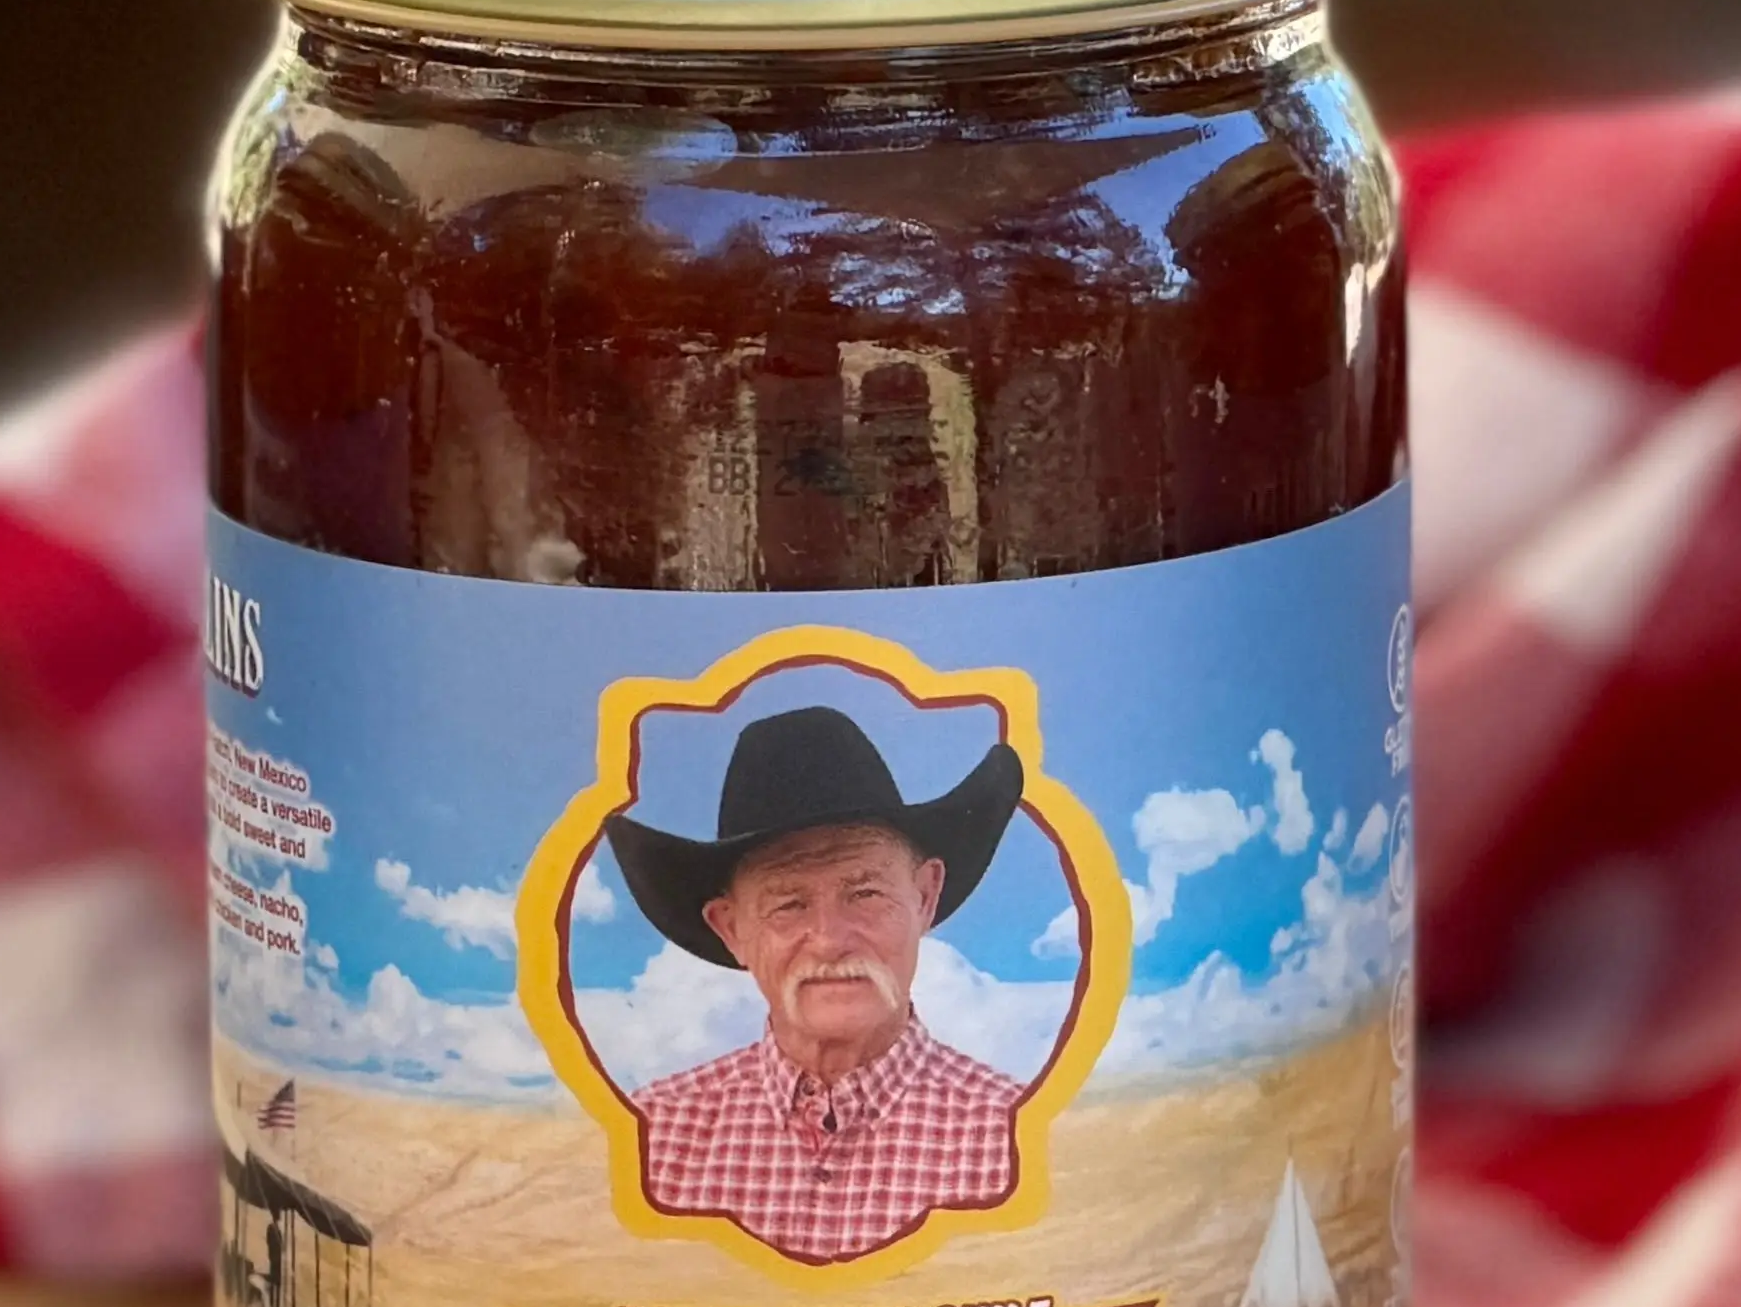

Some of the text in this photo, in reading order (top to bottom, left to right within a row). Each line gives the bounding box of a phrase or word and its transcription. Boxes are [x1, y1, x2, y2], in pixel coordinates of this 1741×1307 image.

[259, 757, 307, 793] Mexico
[260, 795, 269, 814] a
[271, 799, 332, 833] versatile
[279, 836, 306, 859] and
[260, 893, 304, 927] nacho,
[267, 929, 301, 956] pork.
